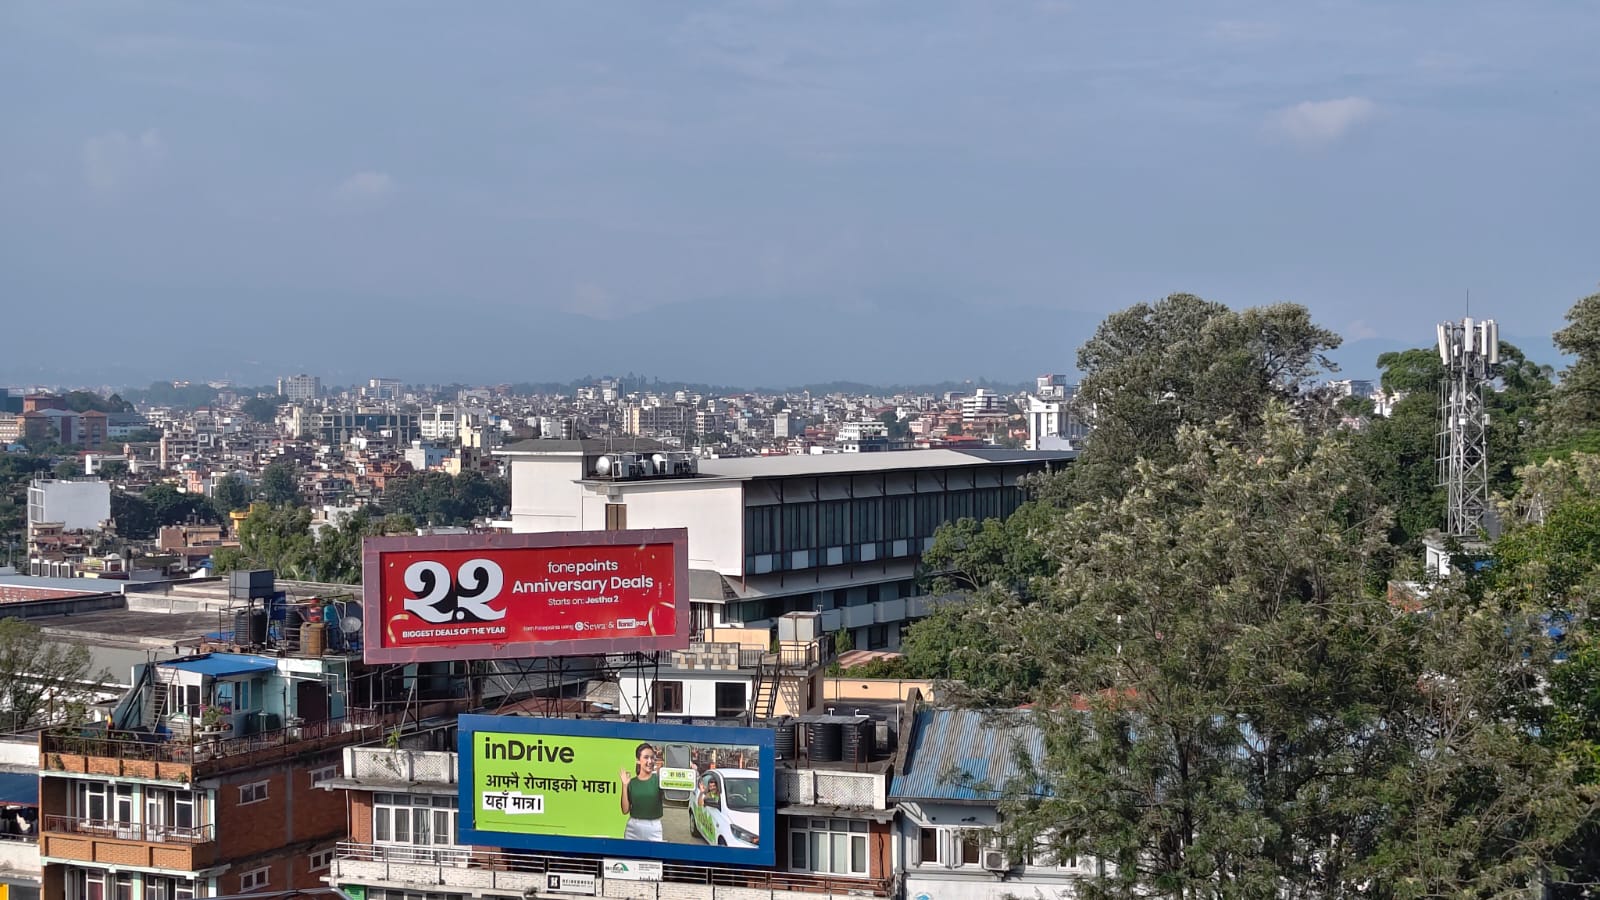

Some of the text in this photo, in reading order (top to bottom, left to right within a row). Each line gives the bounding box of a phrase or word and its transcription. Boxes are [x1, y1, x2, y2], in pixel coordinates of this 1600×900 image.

[547, 559, 619, 576] fonepoints
[404, 558, 507, 623] 2.2
[512, 574, 654, 595] Anniversary Deals
[548, 598, 571, 606] Starts
[585, 595, 613, 604] Jestha
[613, 594, 619, 603] 2
[402, 629, 435, 638] BIGGEST
[435, 628, 459, 636] DEALS
[460, 627, 470, 635] OF
[486, 626, 506, 634] YEAR
[608, 621, 615, 629] &
[485, 737, 575, 763] inDrive
[486, 771, 617, 794] आफ्नै रोजाइको भाडा।
[485, 790, 541, 811] यहाँ मात्र।
